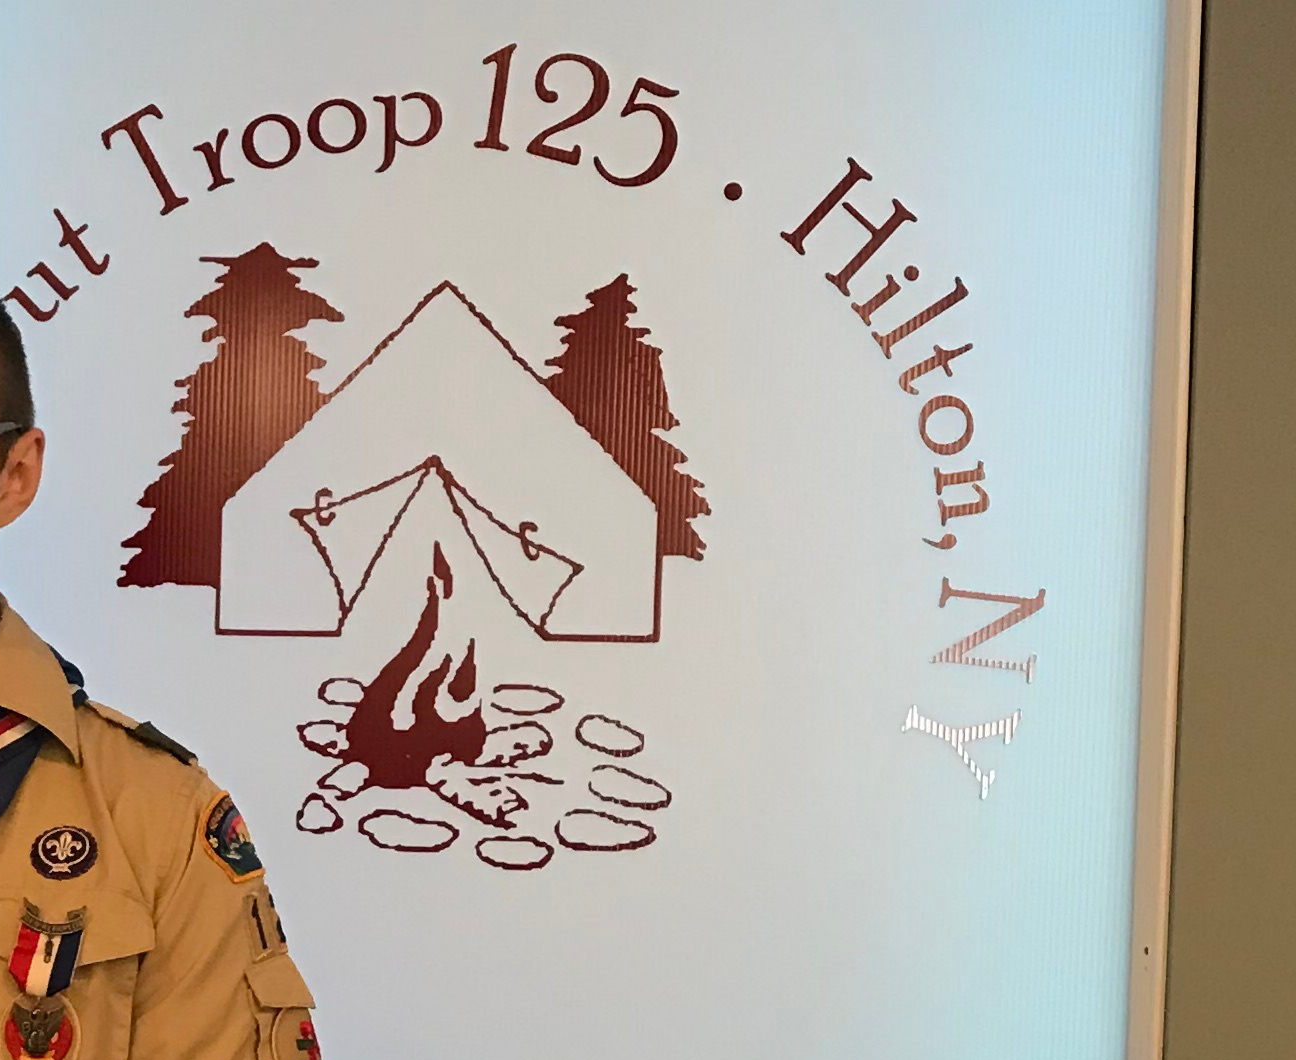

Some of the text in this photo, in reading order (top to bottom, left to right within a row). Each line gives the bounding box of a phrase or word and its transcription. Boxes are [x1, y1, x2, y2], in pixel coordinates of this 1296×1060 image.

[100, 91, 443, 216] Troop
[473, 43, 680, 188] 125
[780, 156, 990, 550] Hilton,
[900, 576, 1047, 801] NY
